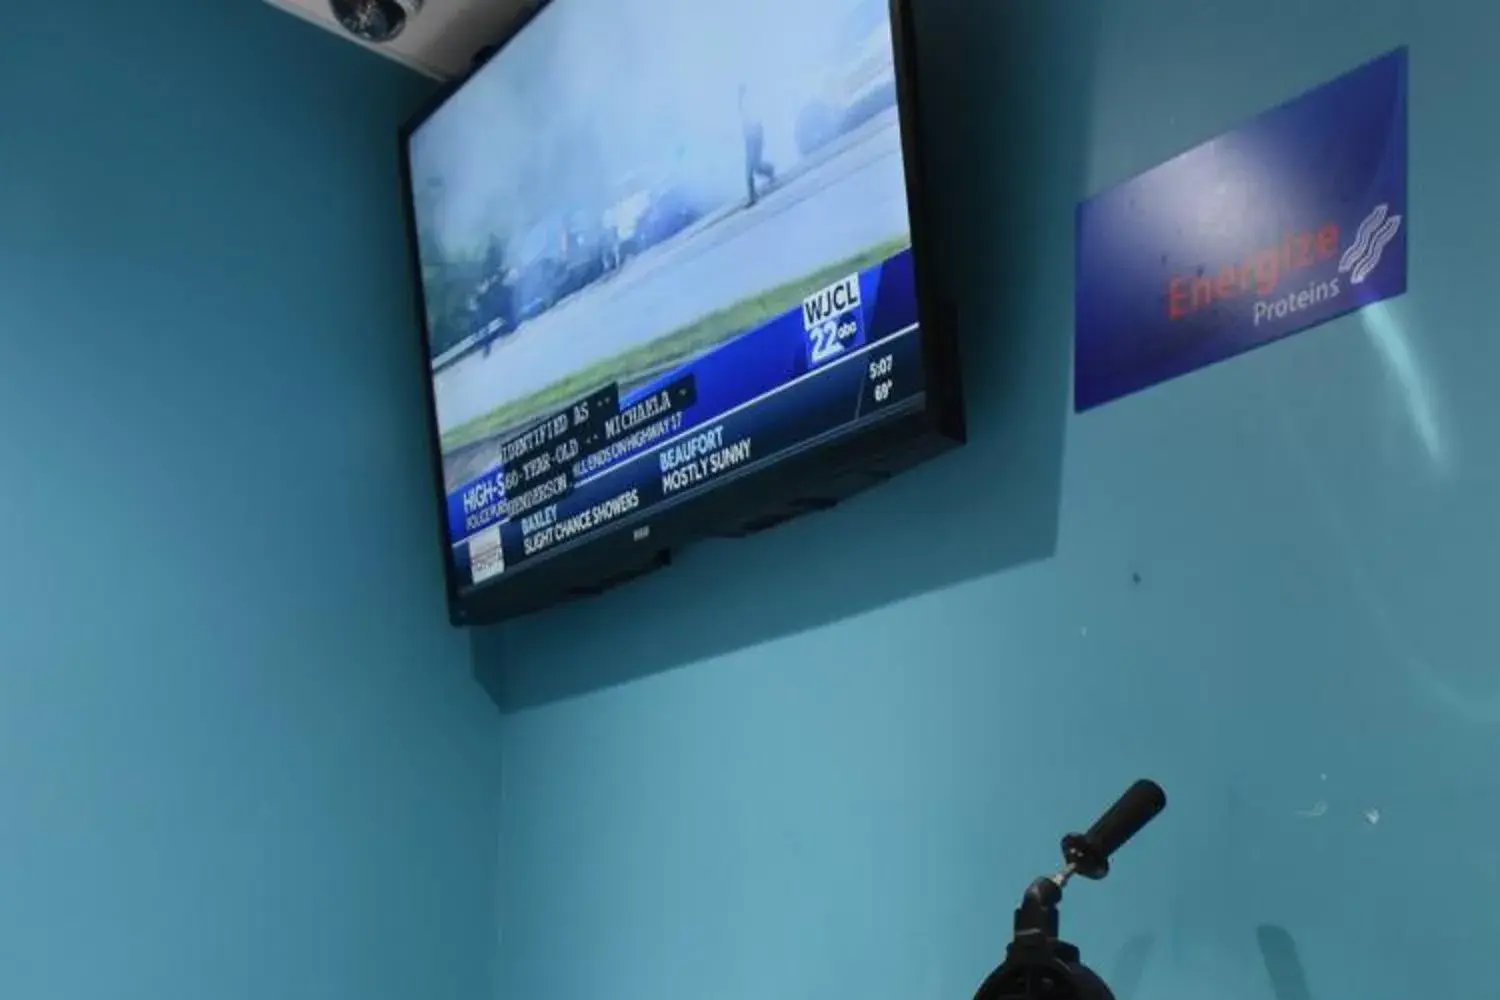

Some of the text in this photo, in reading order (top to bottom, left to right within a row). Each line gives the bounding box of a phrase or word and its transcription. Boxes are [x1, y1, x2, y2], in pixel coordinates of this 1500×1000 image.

[1167, 222, 1340, 320] Energize
[805, 281, 858, 325] WJCL
[1253, 277, 1340, 326] Proteins
[809, 320, 845, 364] 22
[869, 354, 893, 380] 5:07
[500, 401, 589, 463] IDENTIFIED AS
[604, 391, 671, 440] MICHAELA
[660, 425, 724, 473] BEAUFORT
[662, 437, 751, 494] MOSTLY SUNNY
[521, 504, 558, 536] BAXLEY
[523, 489, 640, 556] SLIGHT CHANCE SHOWERS
